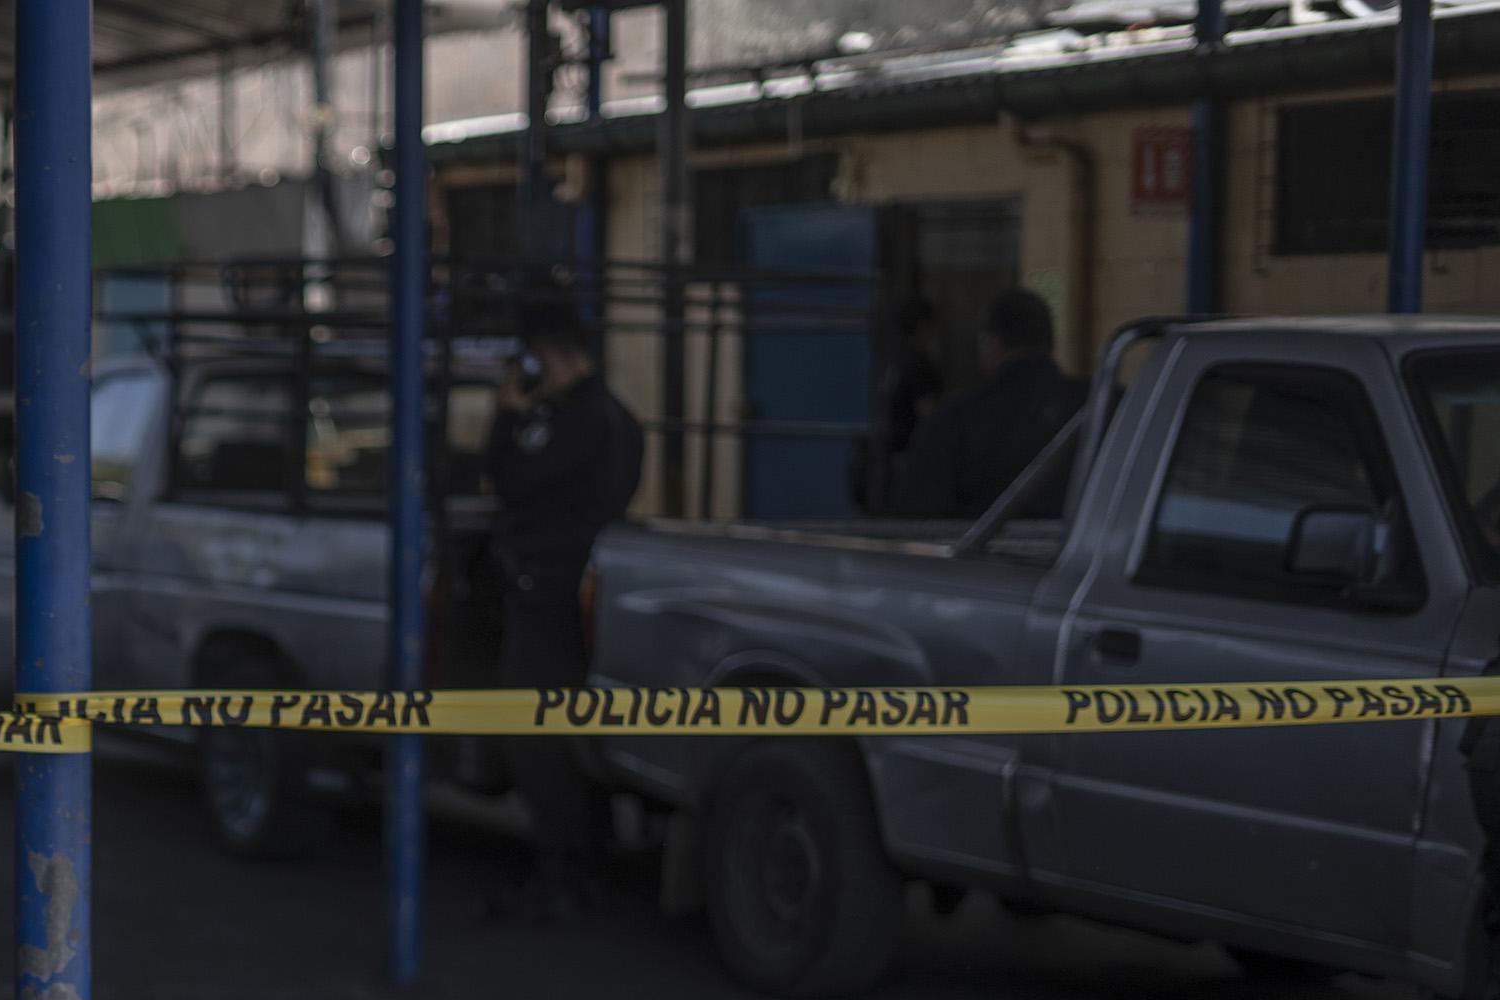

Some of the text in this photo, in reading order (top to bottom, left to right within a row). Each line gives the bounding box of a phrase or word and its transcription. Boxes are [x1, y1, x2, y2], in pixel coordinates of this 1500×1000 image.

[181, 695, 254, 727] NO
[270, 691, 434, 728] PASAR
[534, 688, 971, 726] POLICIA NO PASAR
[1062, 684, 1472, 723] POLICIA NO PASAR
